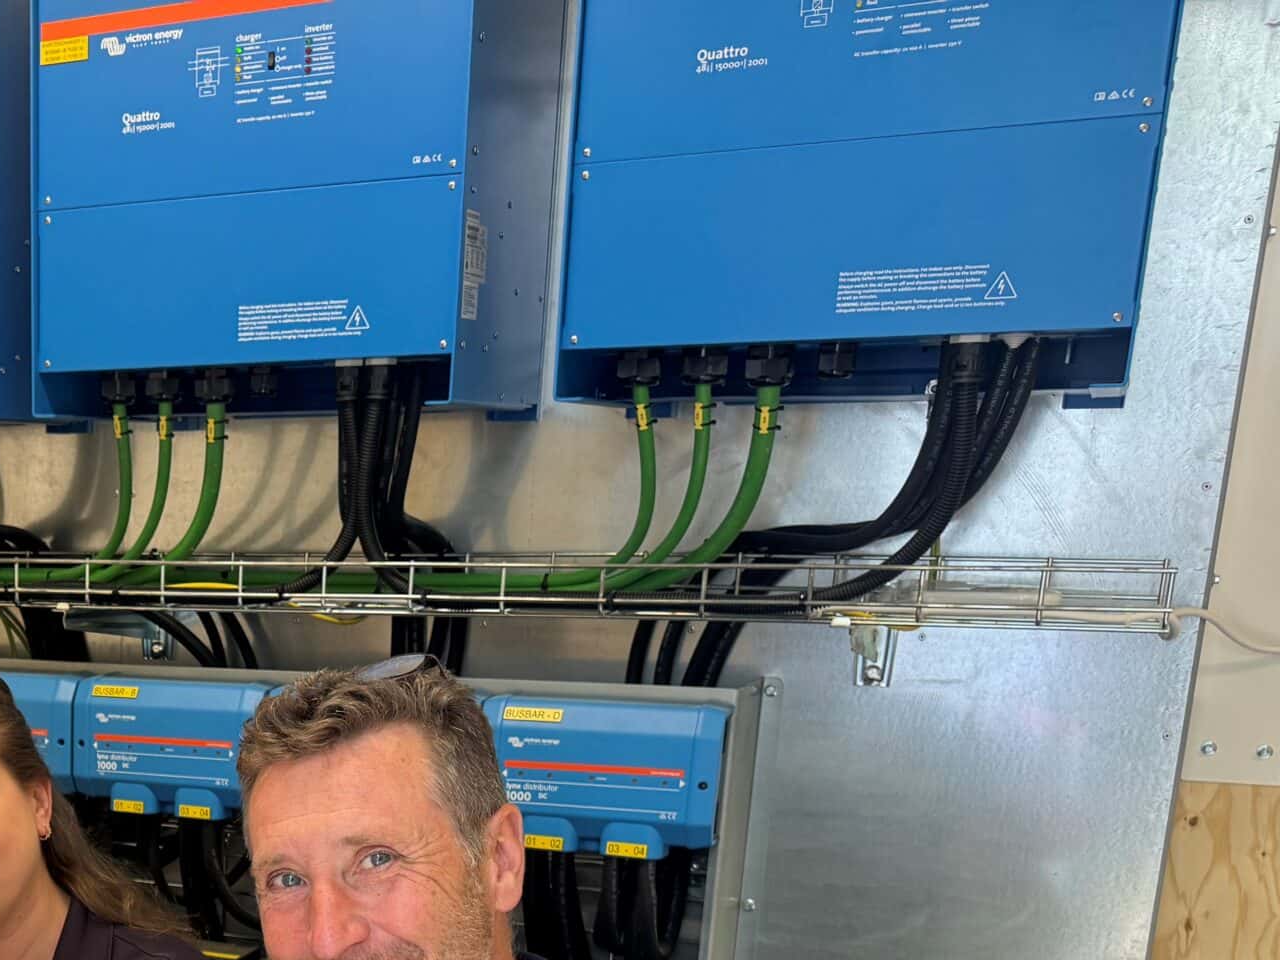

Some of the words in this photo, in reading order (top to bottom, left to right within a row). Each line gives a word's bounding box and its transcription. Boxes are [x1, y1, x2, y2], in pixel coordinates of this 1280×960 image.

[125, 32, 152, 43] victron
[154, 29, 183, 40] energy
[697, 45, 749, 64] Quattro
[122, 111, 160, 127] Quattro
[505, 707, 545, 719] BUSBAR
[552, 711, 561, 720] D
[97, 760, 117, 770] 1000
[523, 782, 559, 792] distributor
[506, 790, 532, 801] 1000
[526, 834, 536, 846] 01
[550, 838, 561, 849] 02
[607, 843, 620, 854] 03
[633, 846, 645, 856] 04
